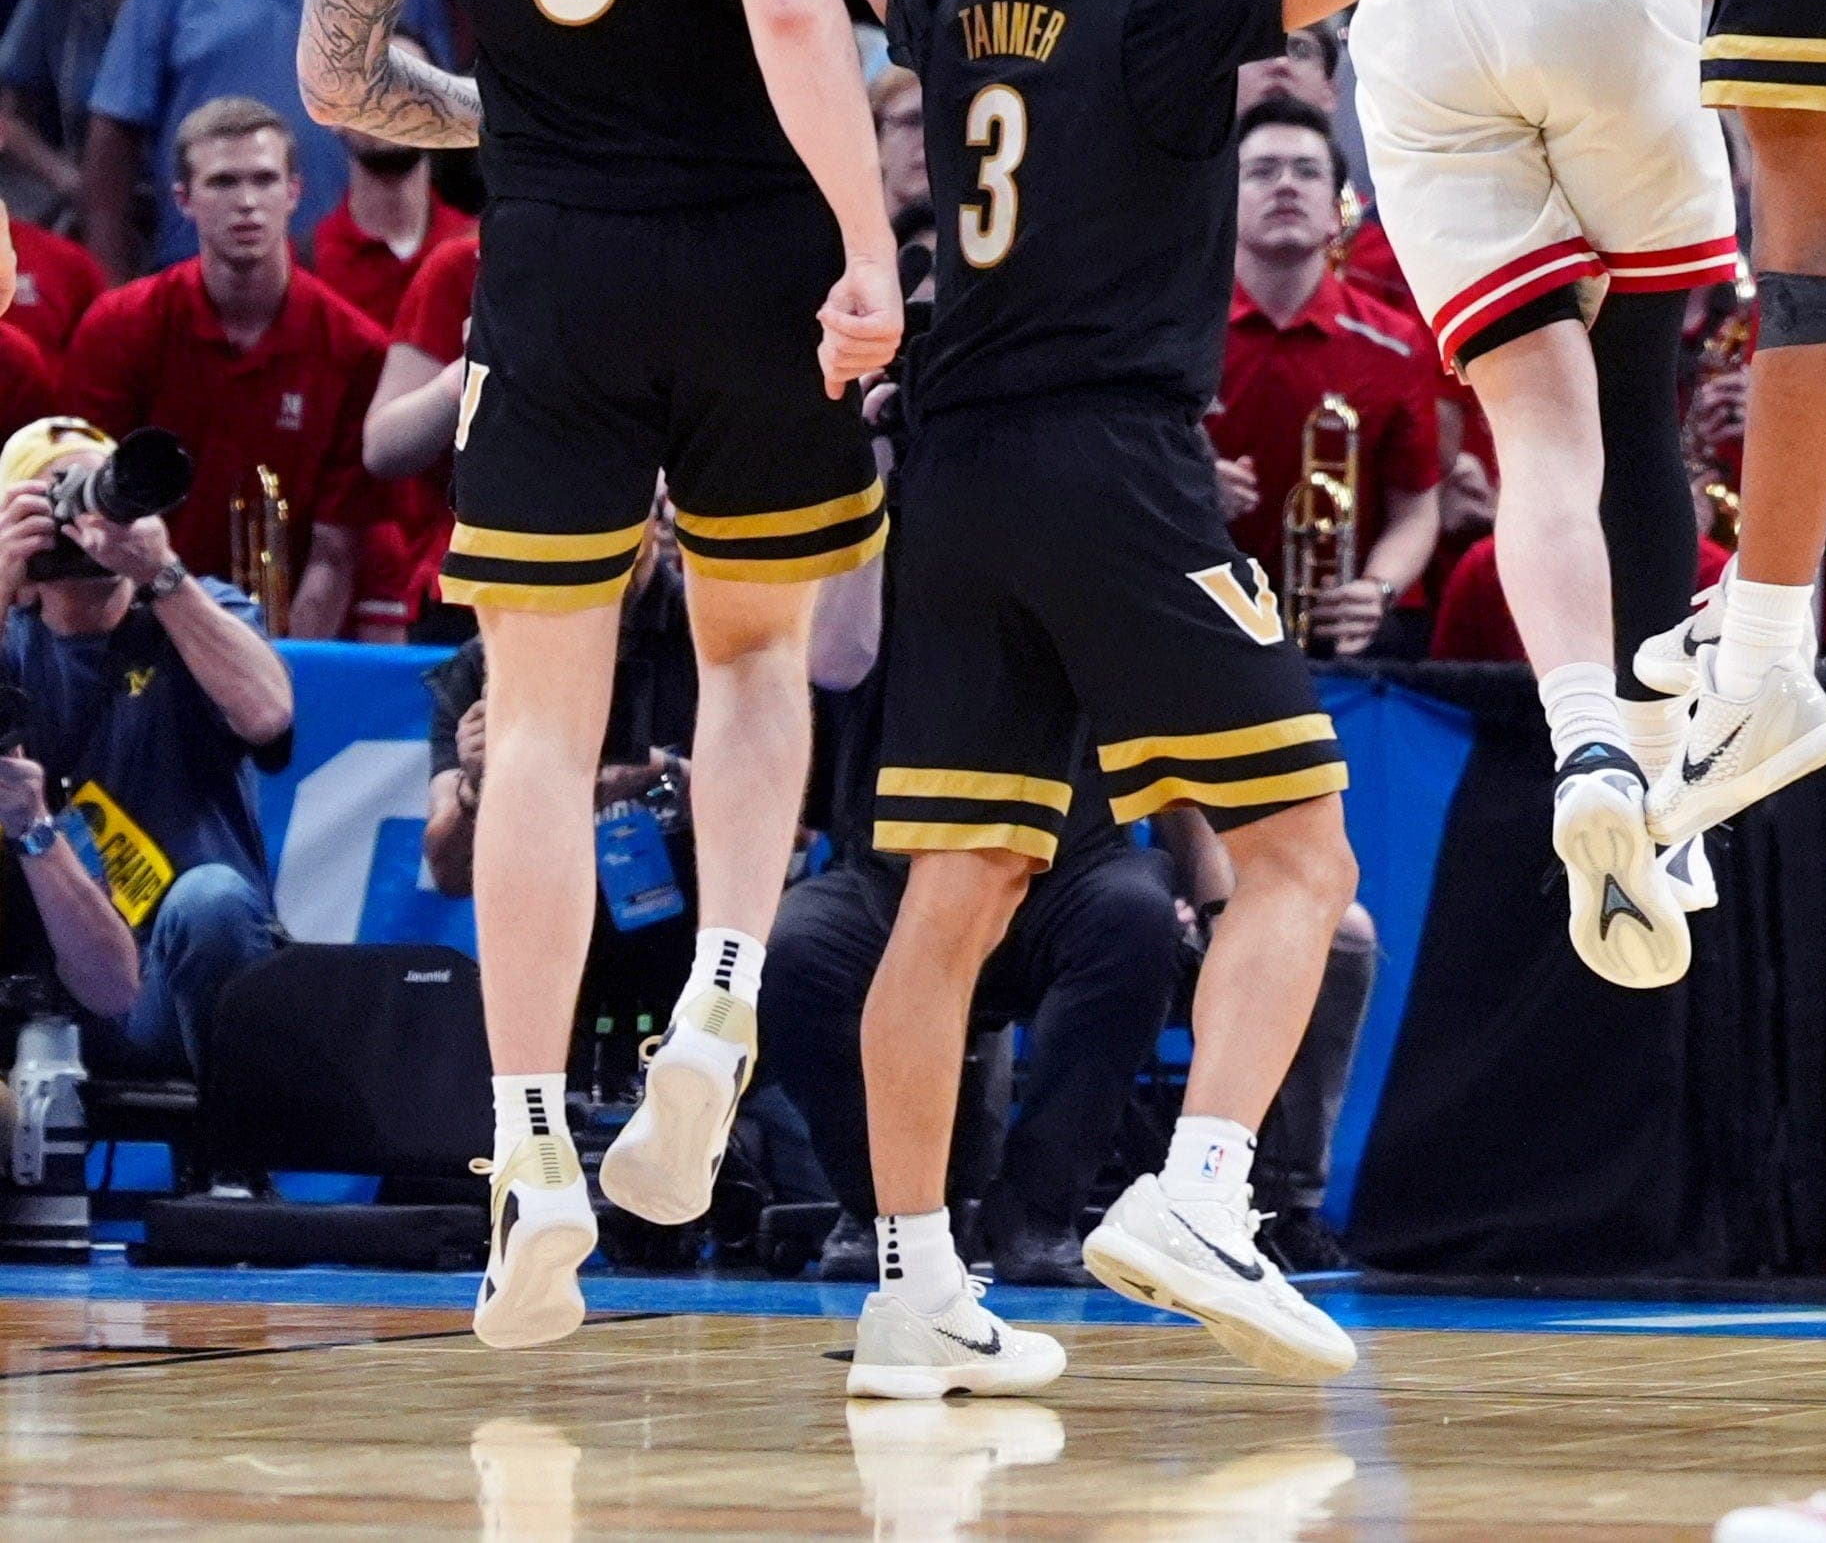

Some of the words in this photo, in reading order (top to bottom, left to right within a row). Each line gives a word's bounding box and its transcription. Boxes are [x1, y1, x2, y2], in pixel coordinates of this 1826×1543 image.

[958, 1, 1069, 63] TANNER
[958, 83, 1029, 269] 3
[1185, 557, 1284, 646] V
